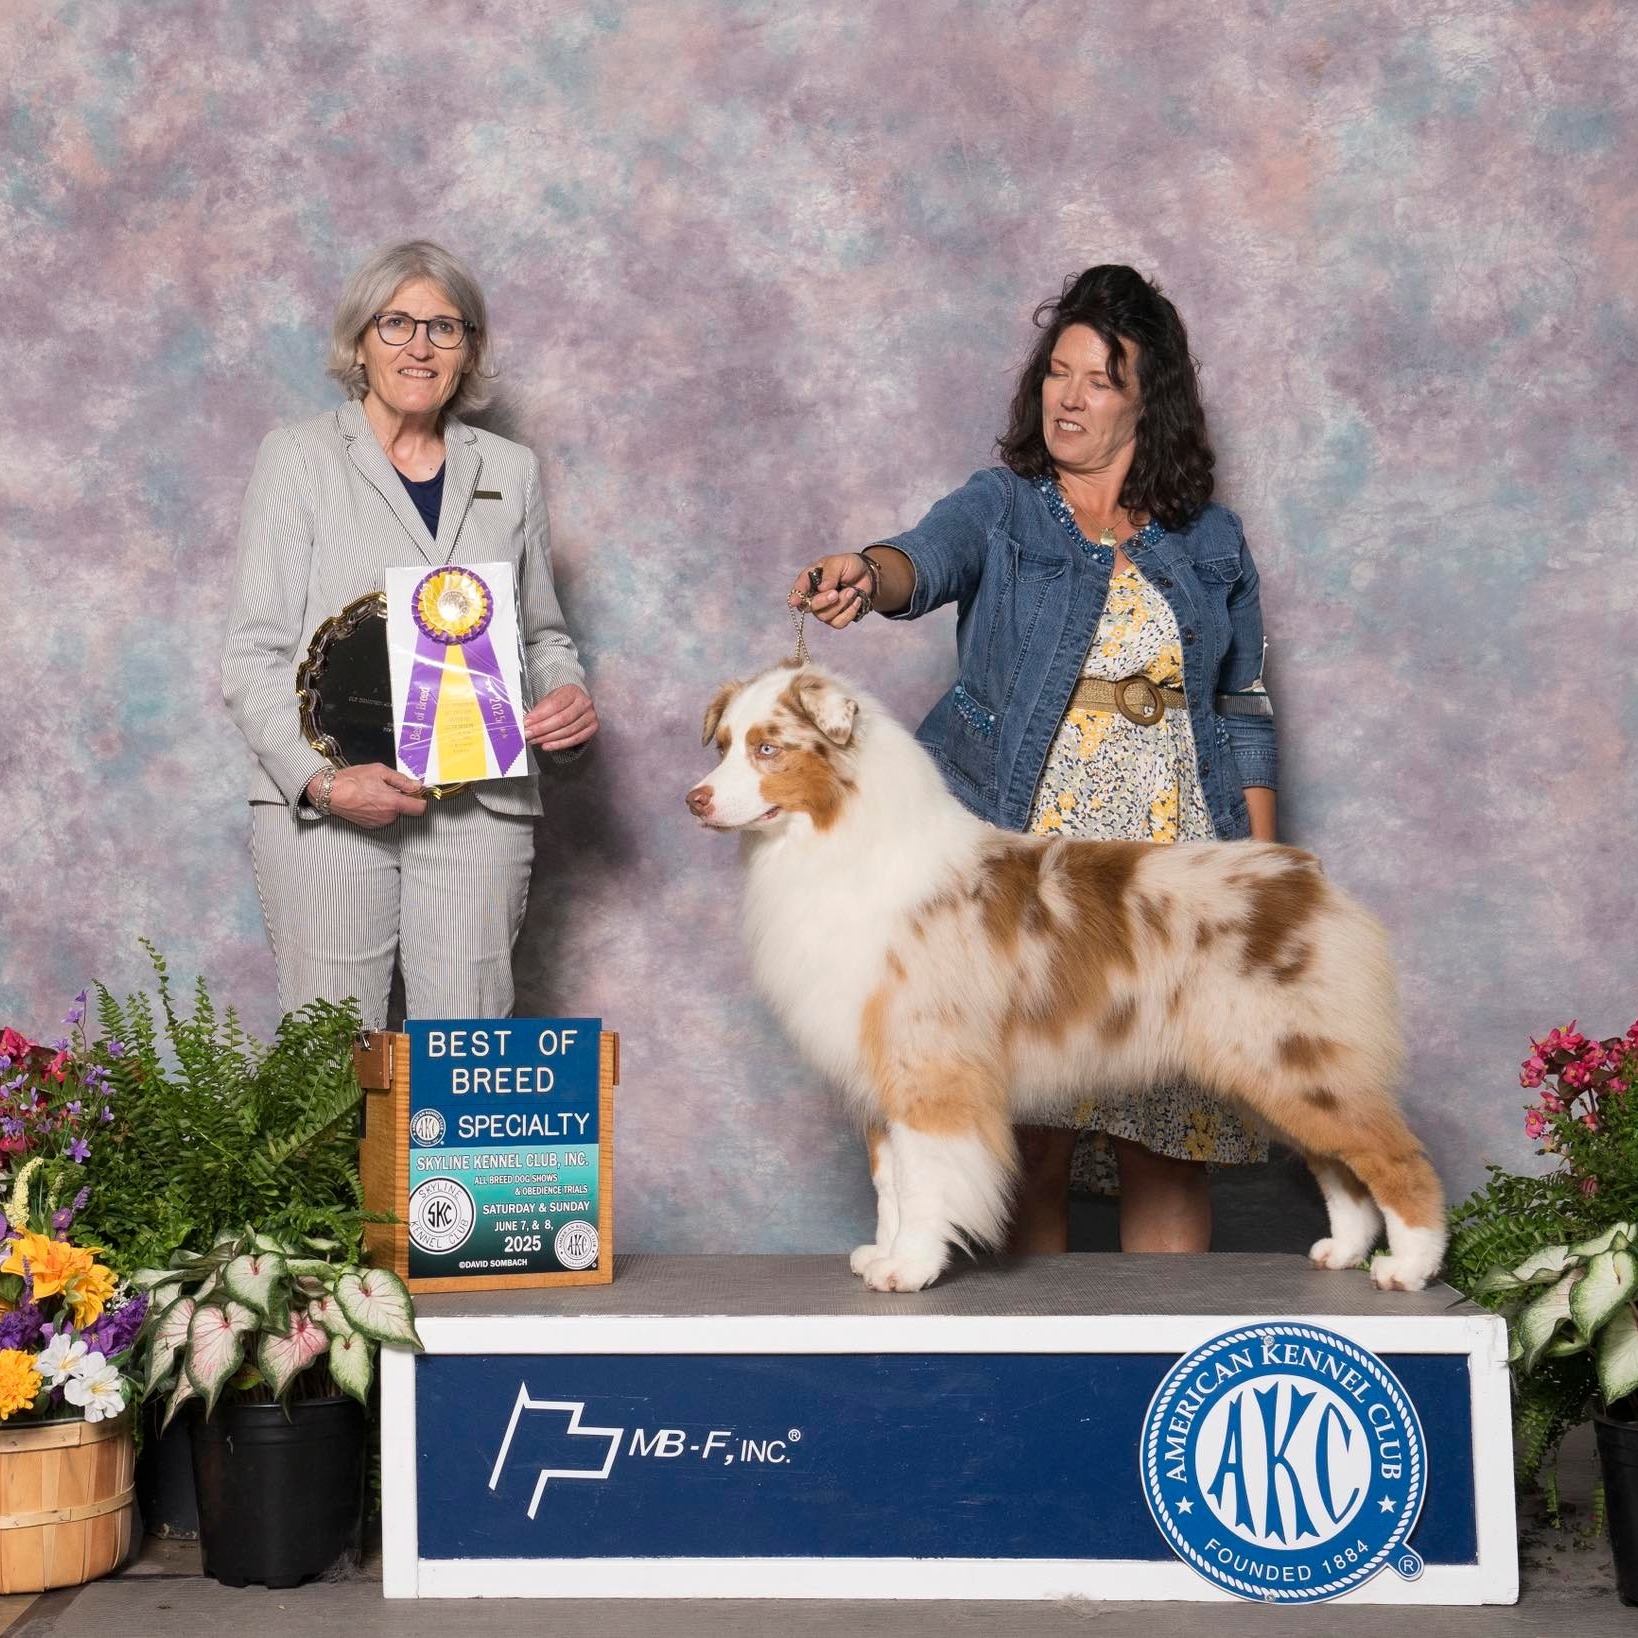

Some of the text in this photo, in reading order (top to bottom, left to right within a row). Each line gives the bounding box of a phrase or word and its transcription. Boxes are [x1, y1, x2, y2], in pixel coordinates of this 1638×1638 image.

[416, 686, 430, 710] Breed
[414, 712, 425, 720] of
[428, 1030, 578, 1057] BEST OF
[452, 1067, 555, 1094] BREED
[418, 1117, 438, 1139] AKC
[458, 1113, 590, 1138] SPECIALTY
[416, 1151, 589, 1170] SKYLINE KENNEL CLUB, INC.
[474, 1173, 558, 1185] ALL BREED DOG SHOWS
[514, 1184, 588, 1196] & OBEDIENCE TRIALS
[418, 1181, 463, 1200] SKYLINE
[428, 1201, 452, 1228] SKC
[482, 1201, 590, 1215] SATURDAY & SUNDAY
[410, 1218, 469, 1248] KENNEL CLUB
[495, 1219, 554, 1232] JUNE 7, & 8,
[504, 1235, 541, 1252] 2025
[490, 1258, 528, 1268] SOMBACH
[1164, 1342, 1402, 1483] AMERICAN KENNEL CLUB
[1207, 1381, 1360, 1545] AKC
[1204, 1537, 1369, 1582] FOUNDED 1884
